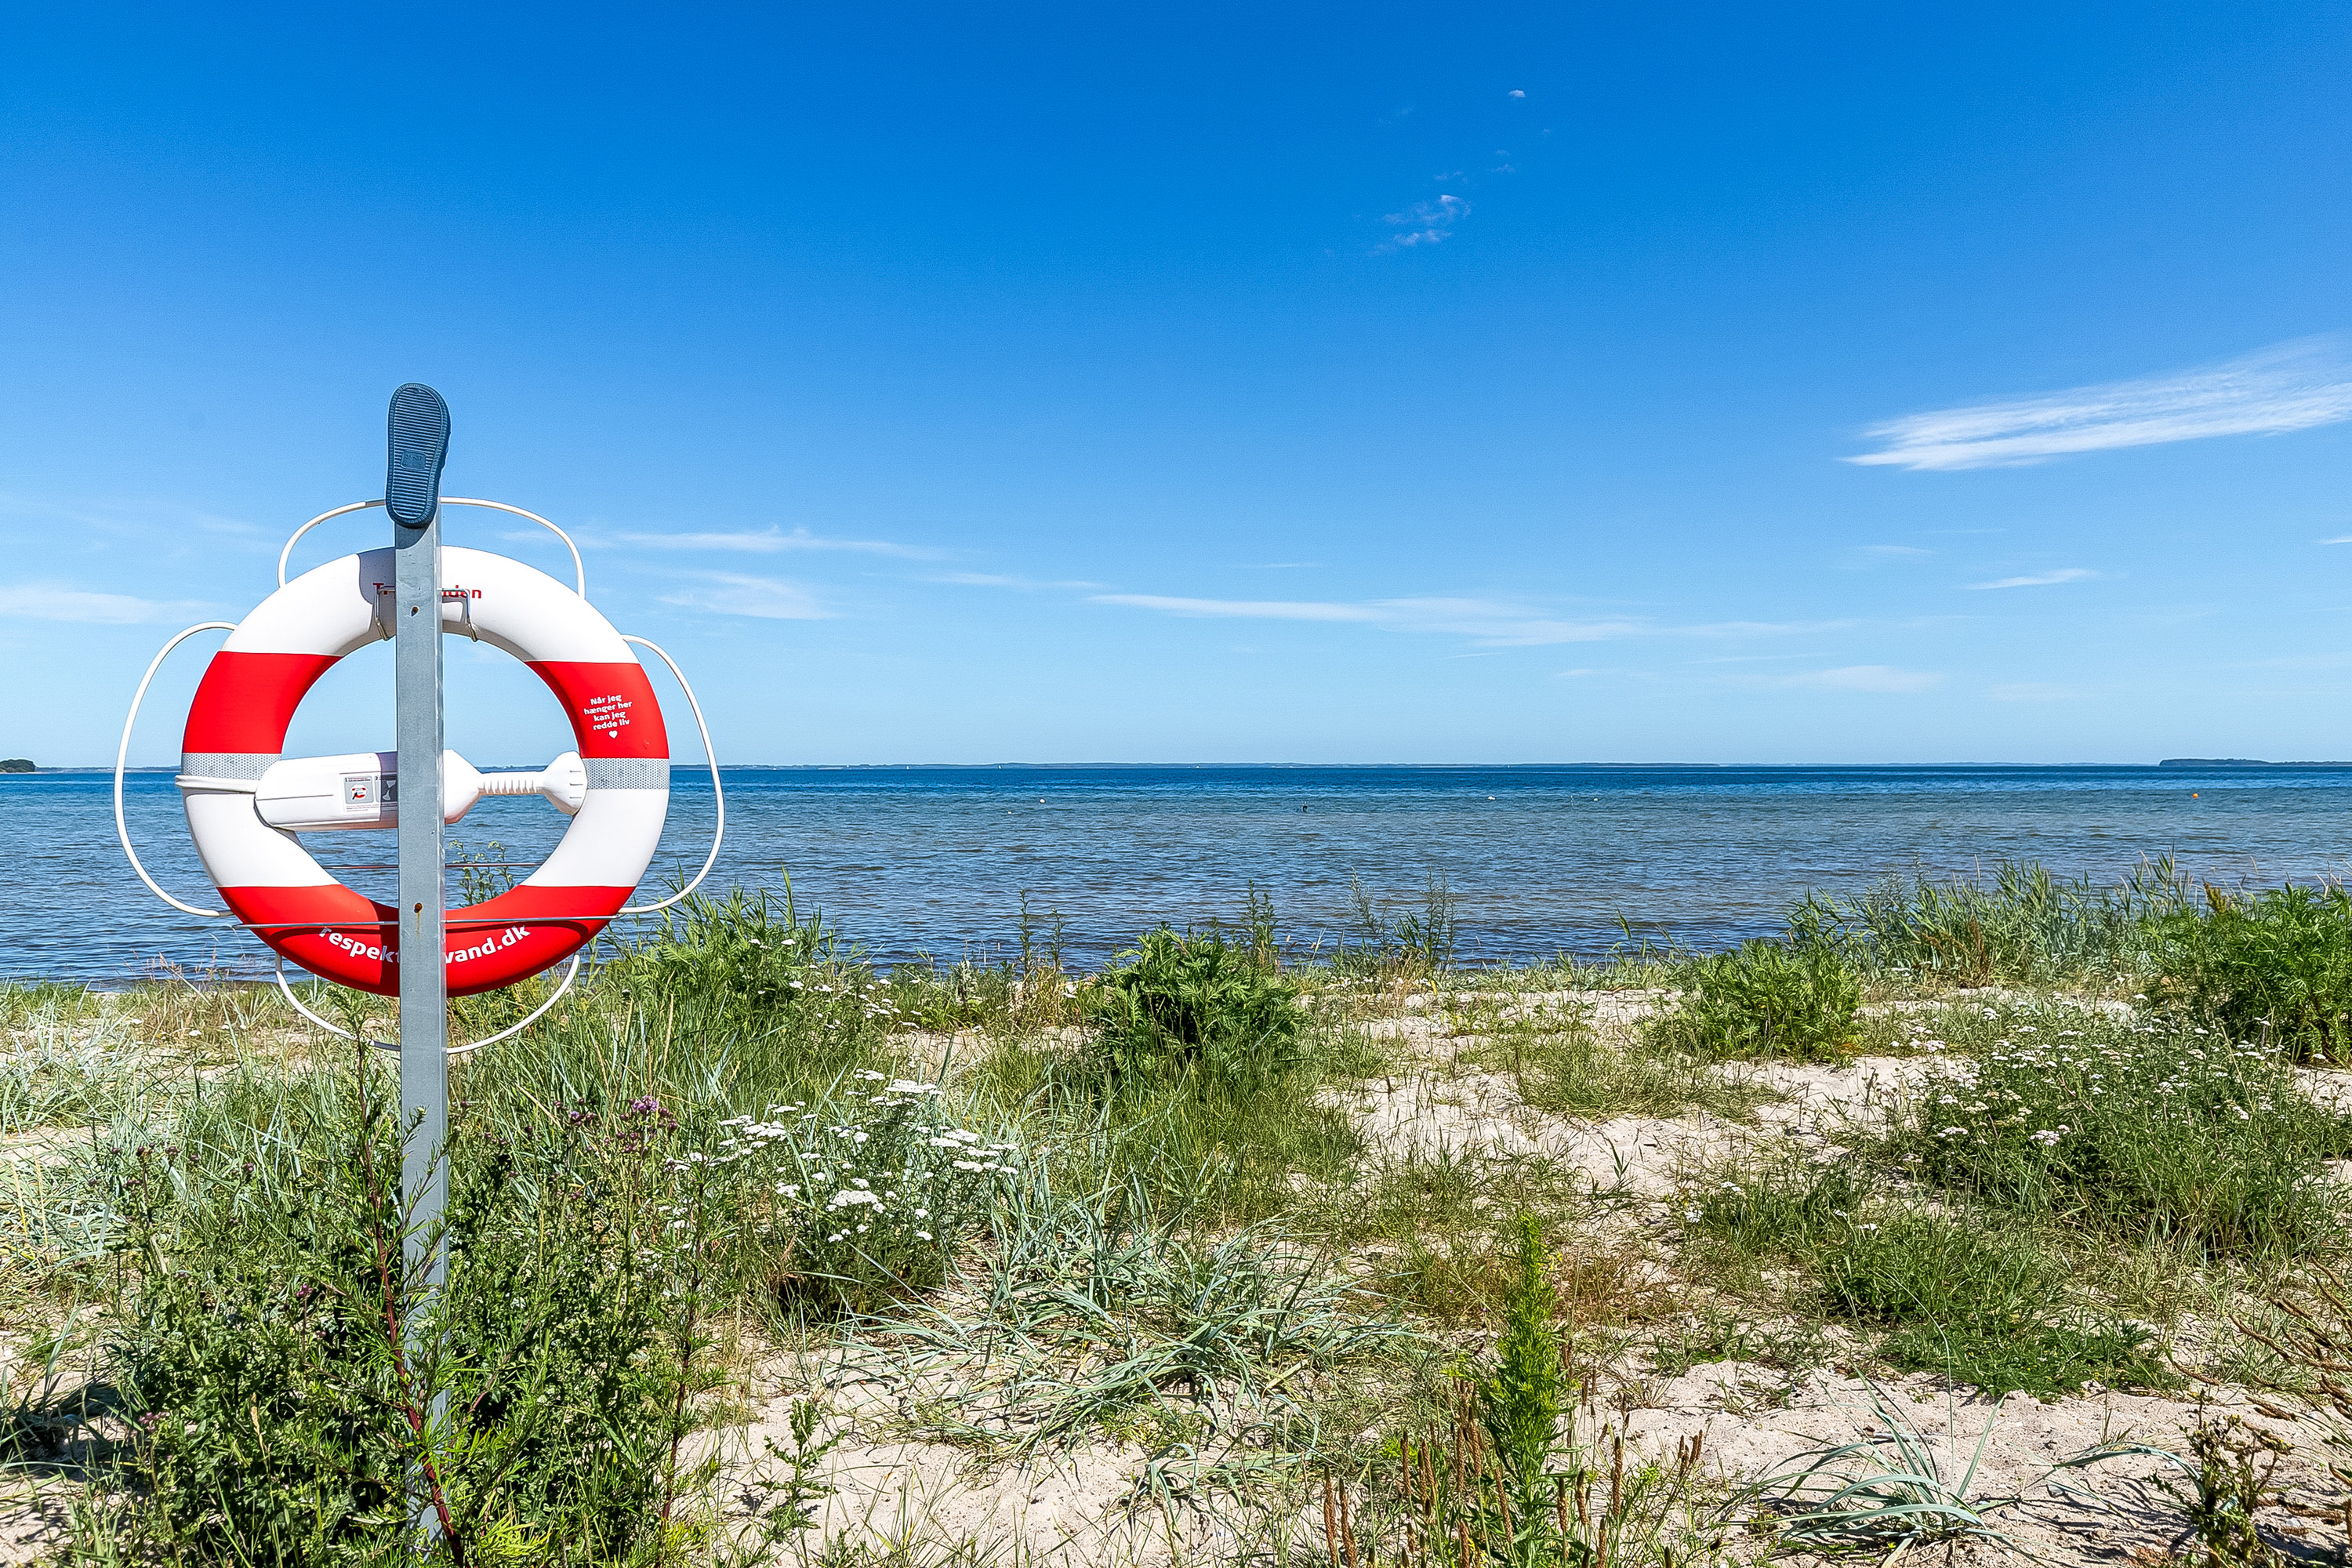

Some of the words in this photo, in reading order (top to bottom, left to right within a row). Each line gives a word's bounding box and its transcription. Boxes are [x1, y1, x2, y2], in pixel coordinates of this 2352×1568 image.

[590, 696, 606, 706] Når
[607, 695, 622, 704] jeg
[583, 704, 616, 715] hænger
[611, 711, 626, 720] jeg
[593, 720, 618, 731] redde
